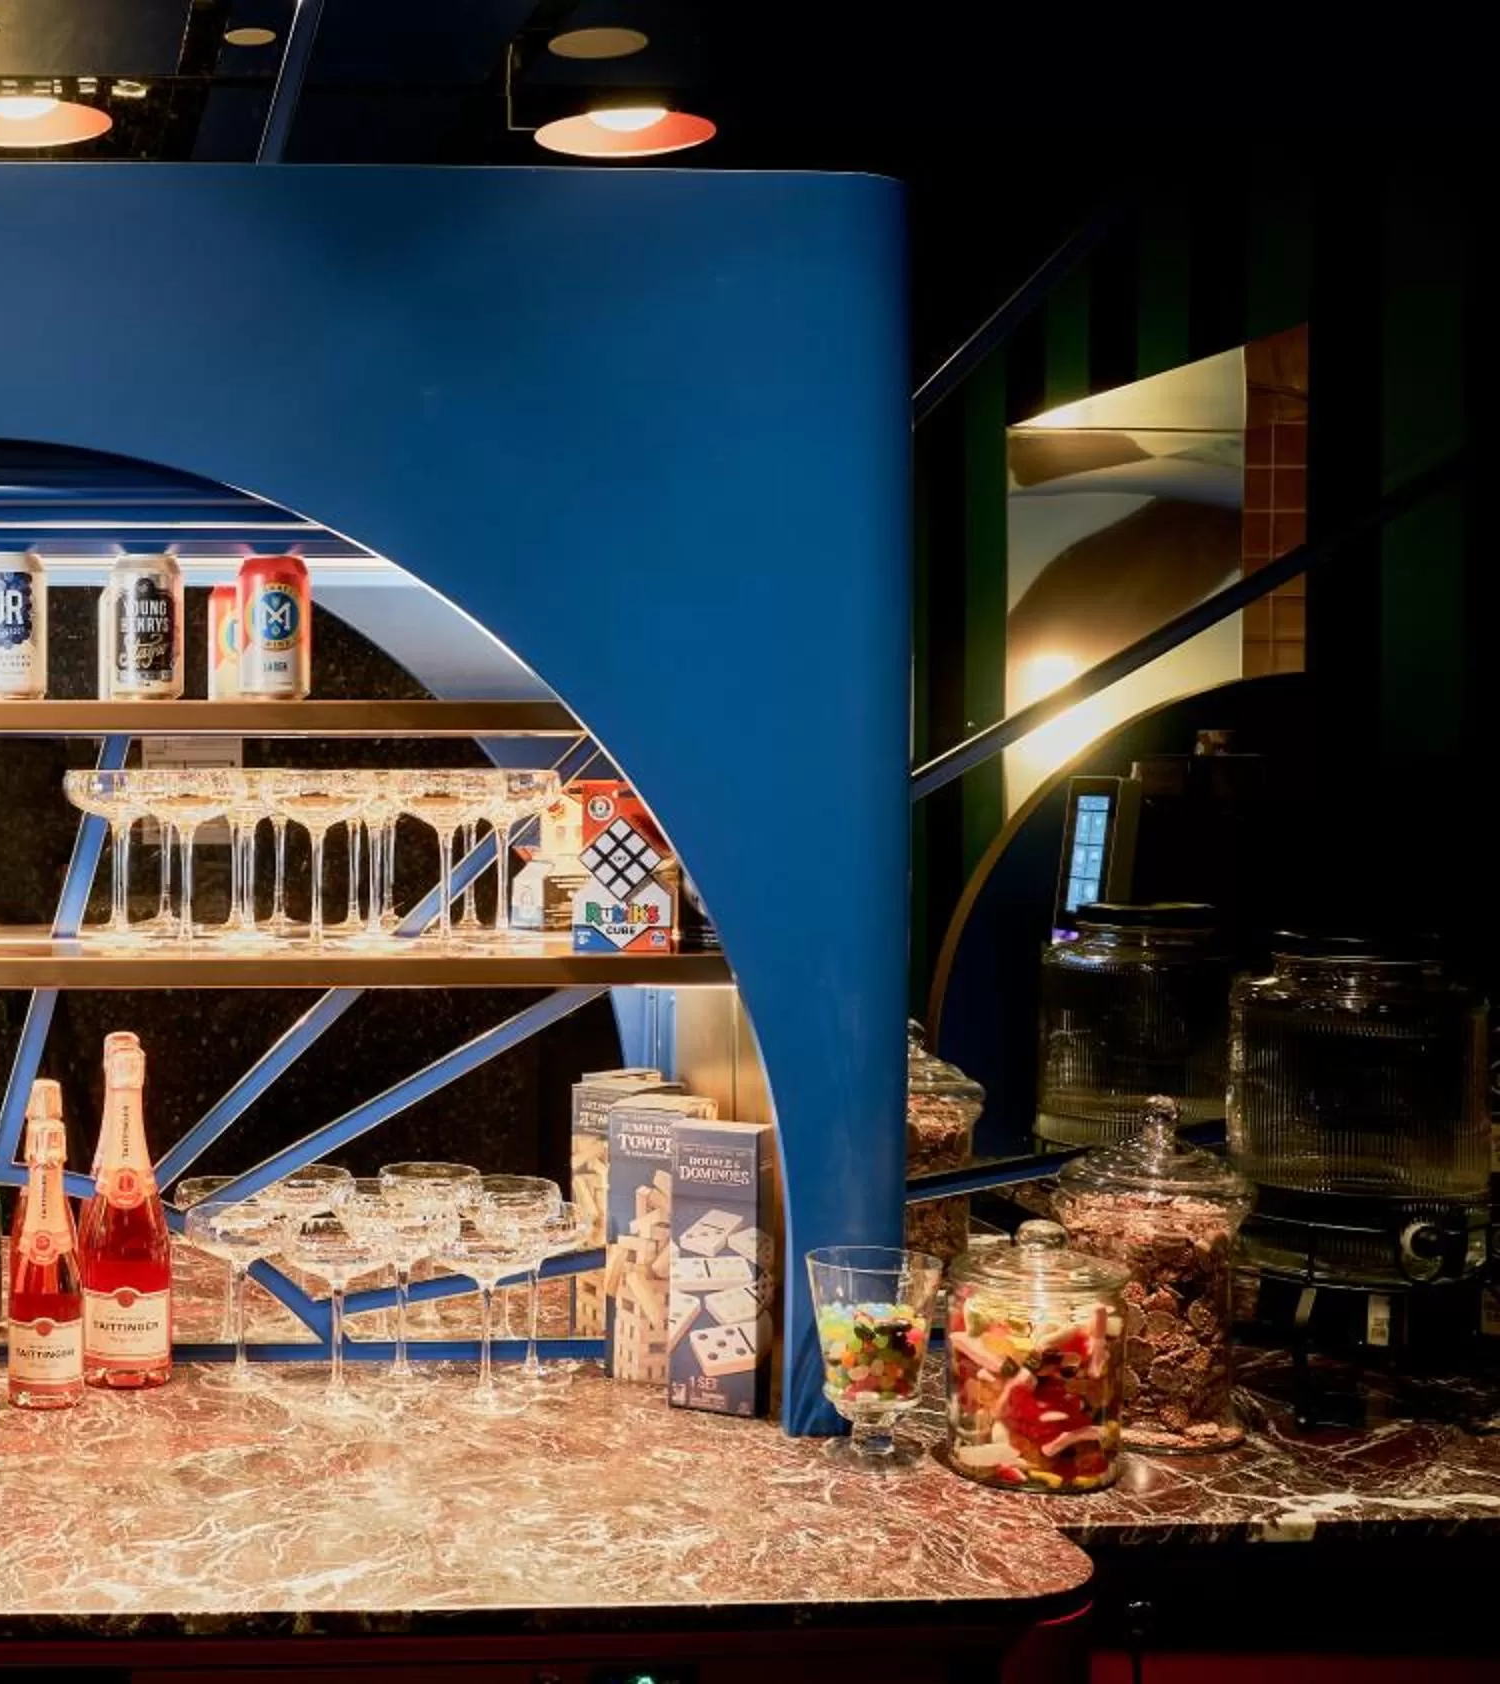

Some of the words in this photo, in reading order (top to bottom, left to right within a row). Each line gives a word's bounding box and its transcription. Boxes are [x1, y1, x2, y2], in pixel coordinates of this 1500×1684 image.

[123, 599, 167, 617] YOUNG
[120, 617, 170, 633] HNRYS
[679, 1164, 750, 1185] DOMINOES
[92, 1321, 159, 1332] TAITTINGER
